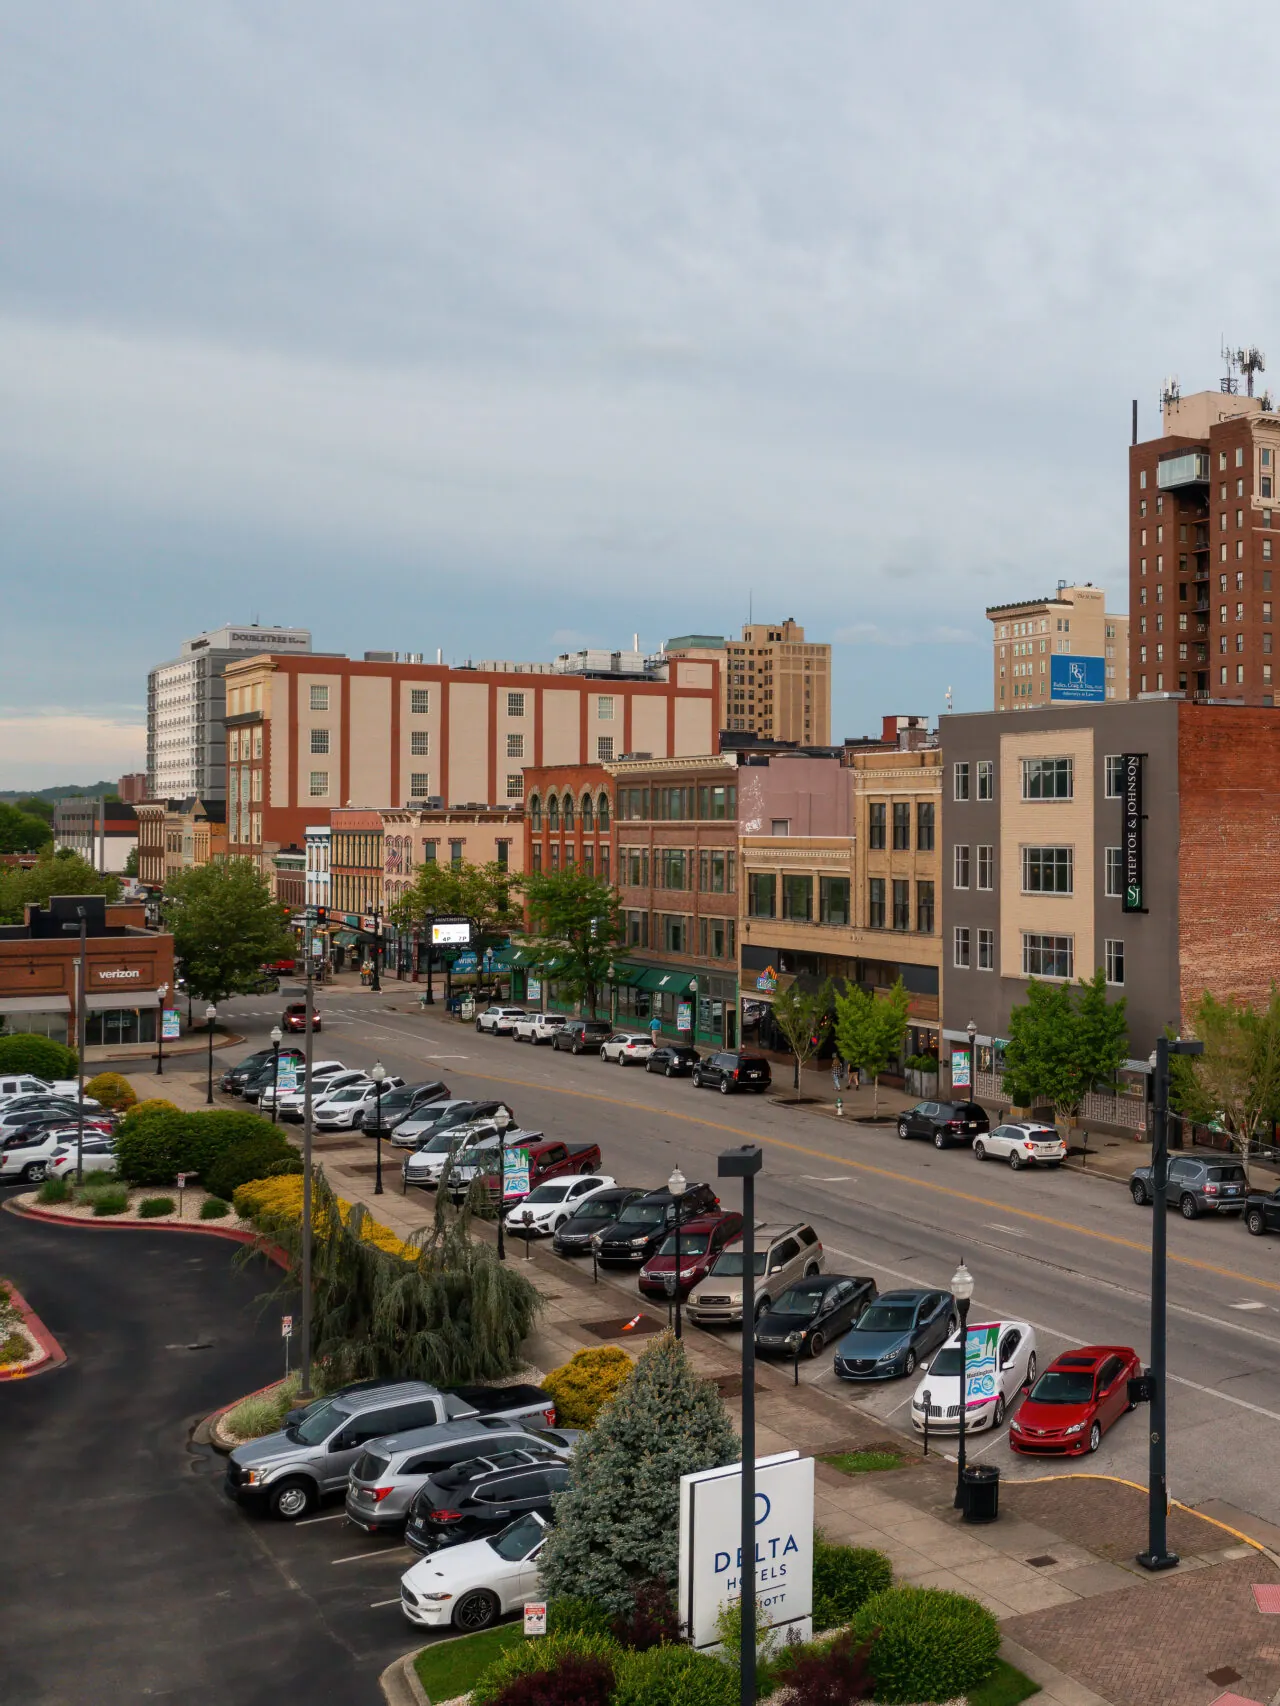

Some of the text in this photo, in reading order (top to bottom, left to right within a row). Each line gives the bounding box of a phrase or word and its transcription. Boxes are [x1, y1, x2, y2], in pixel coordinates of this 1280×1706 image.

[1128, 756, 1138, 816] JOHNSON
[1128, 819, 1137, 828] &
[1128, 832, 1137, 884] STEPTOE
[99, 969, 140, 979] verizon
[966, 1373, 995, 1397] 150
[727, 1563, 787, 1590] HELS
